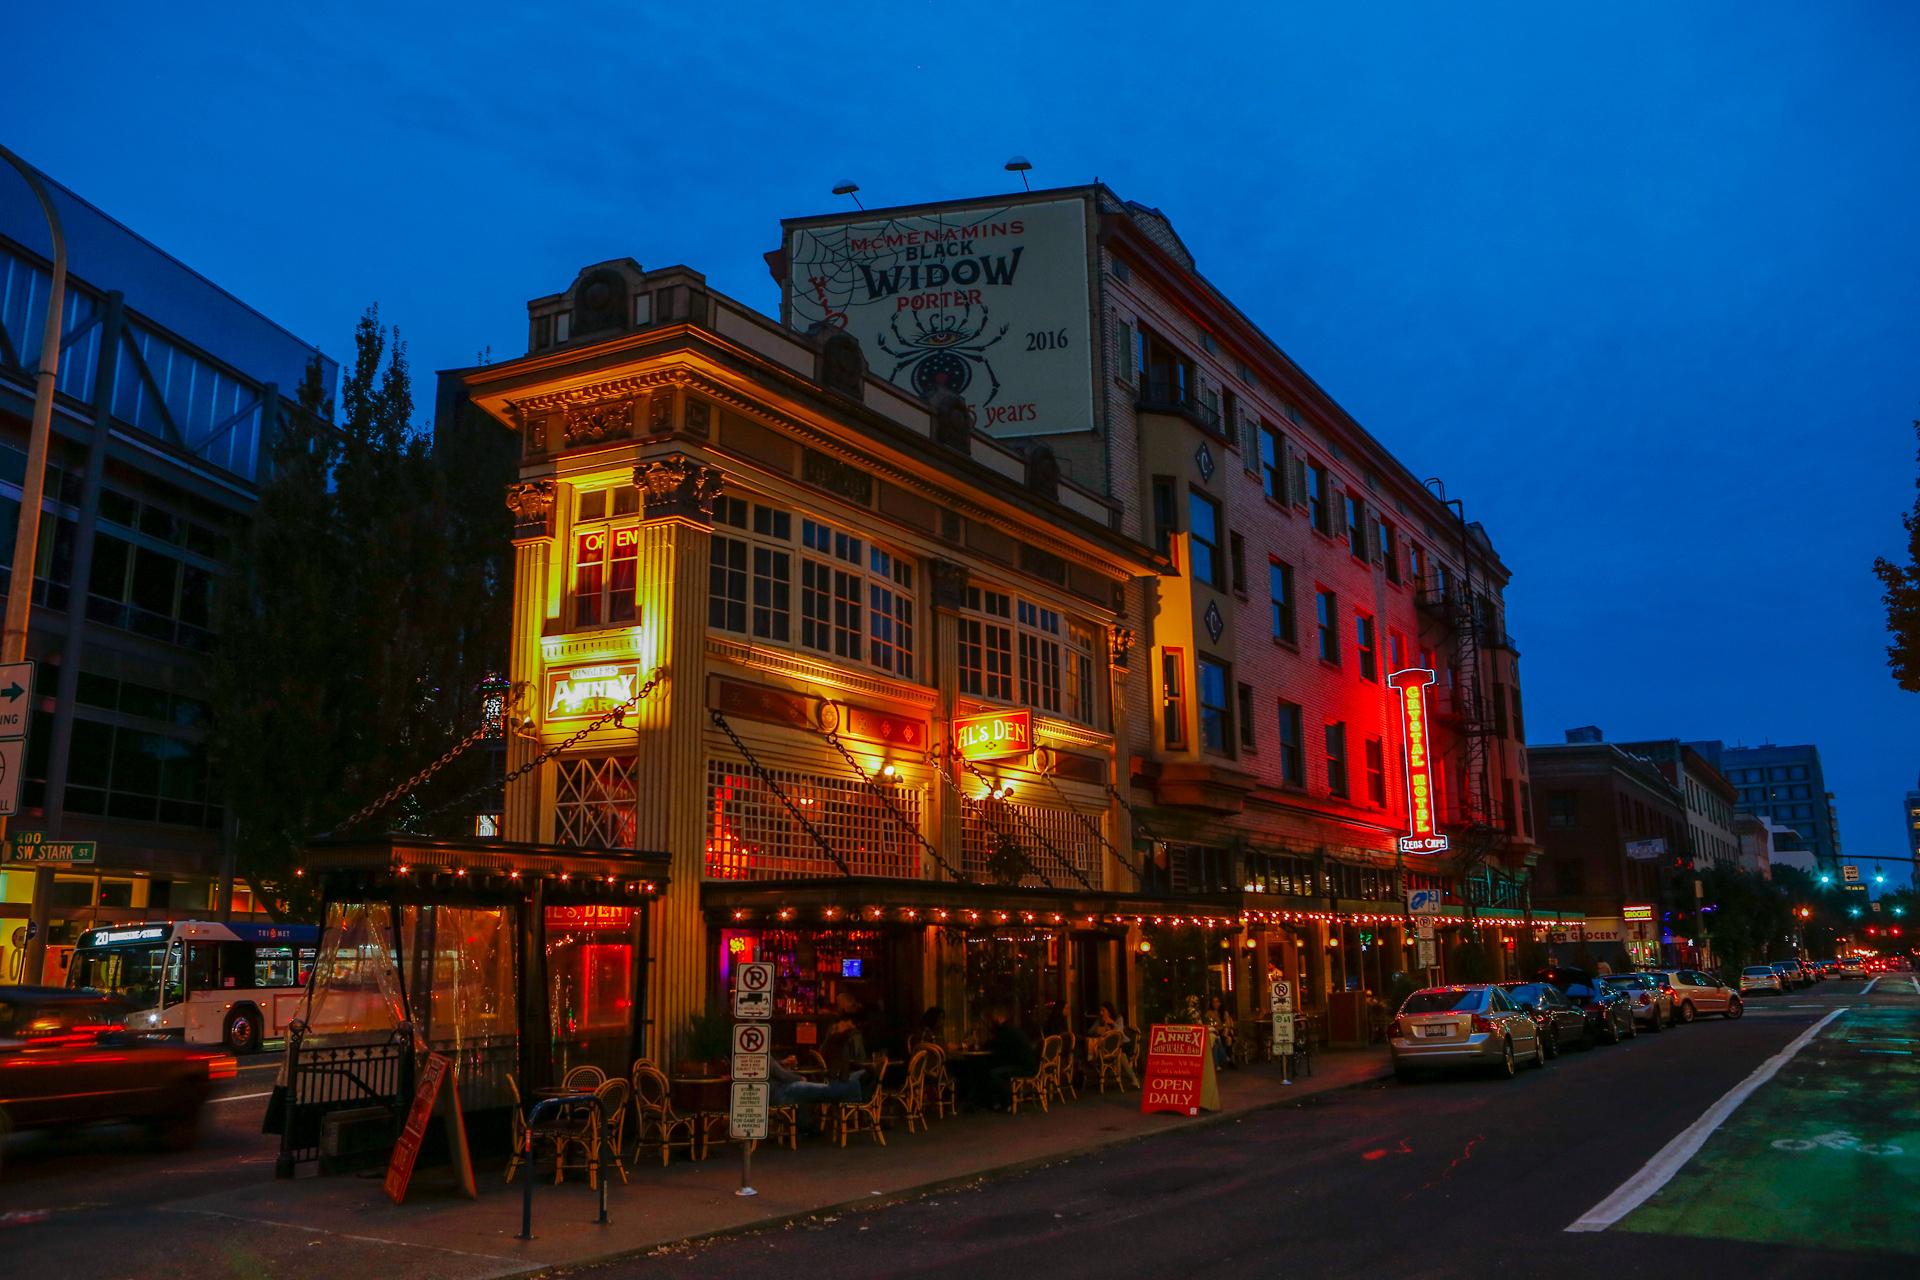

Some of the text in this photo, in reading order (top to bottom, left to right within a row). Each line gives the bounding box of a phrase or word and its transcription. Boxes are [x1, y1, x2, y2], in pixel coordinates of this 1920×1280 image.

[906, 240, 975, 261] BLACK
[857, 246, 1025, 300] WIDOW
[896, 289, 983, 313] PORTER
[1026, 328, 1068, 351] 2016
[984, 402, 1036, 428] years
[586, 530, 638, 551] OPEN
[957, 719, 1026, 750] AL'S DEN
[1406, 686, 1425, 767] CRYSTAL
[1413, 774, 1430, 833] HOTEL
[16, 832, 42, 844] 400
[16, 844, 89, 861] SW STARK ST
[95, 931, 109, 946] 20
[1153, 1031, 1201, 1047] ANNEX
[1152, 1078, 1193, 1091] OPEN
[1149, 1092, 1193, 1105] DAILY
